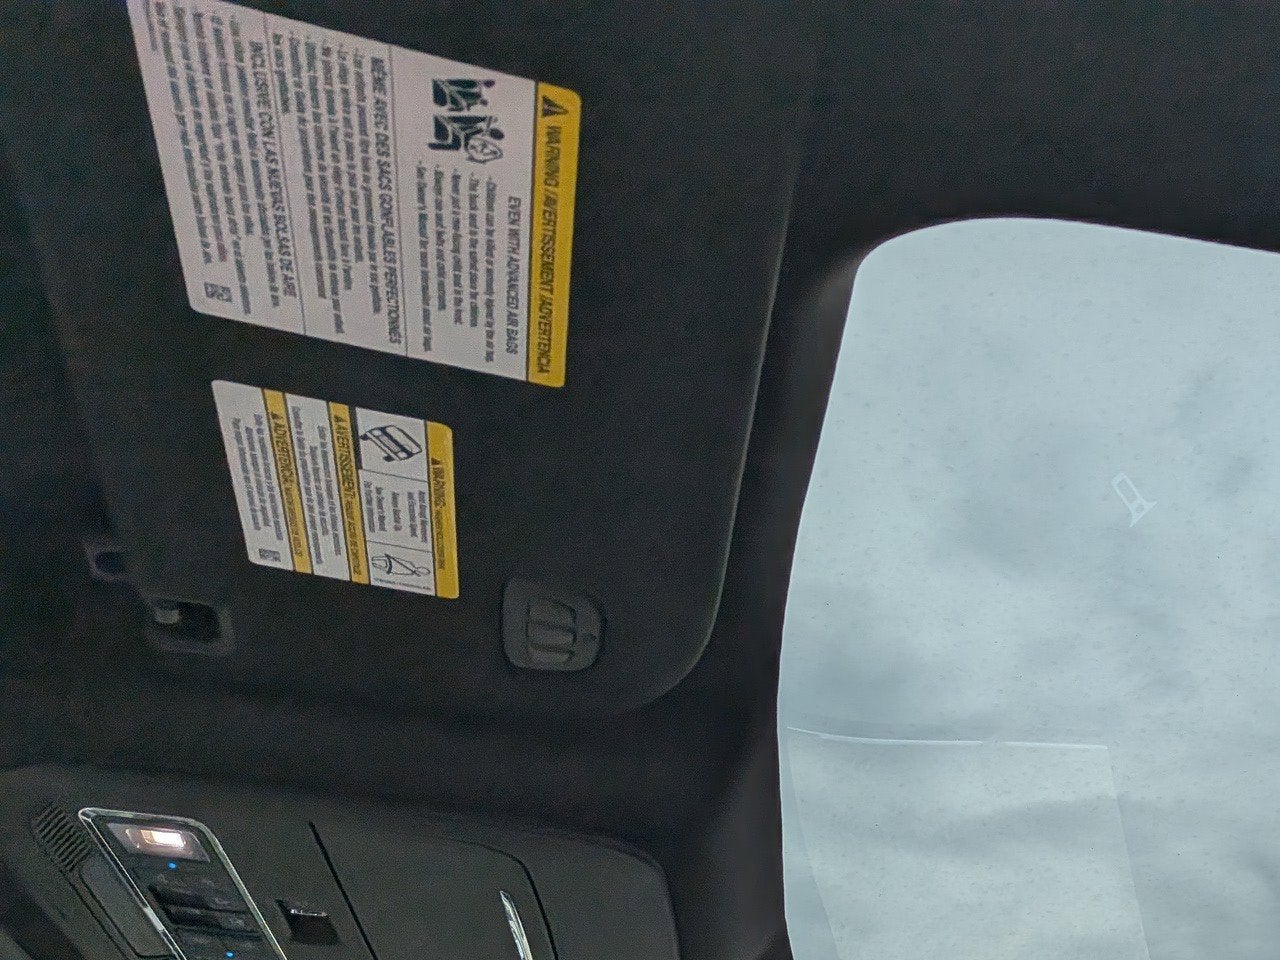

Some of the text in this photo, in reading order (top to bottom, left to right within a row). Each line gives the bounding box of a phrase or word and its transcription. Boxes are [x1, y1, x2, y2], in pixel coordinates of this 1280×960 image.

[257, 109, 276, 141] CON
[262, 139, 279, 166] LAS
[374, 130, 390, 159] DES
[543, 123, 562, 189] WARNING
[375, 157, 392, 192] SACS
[272, 212, 292, 258] BOLSAS
[278, 256, 294, 274] DE
[505, 194, 521, 355] EVEN WITH ADVANCED AIR BAGS
